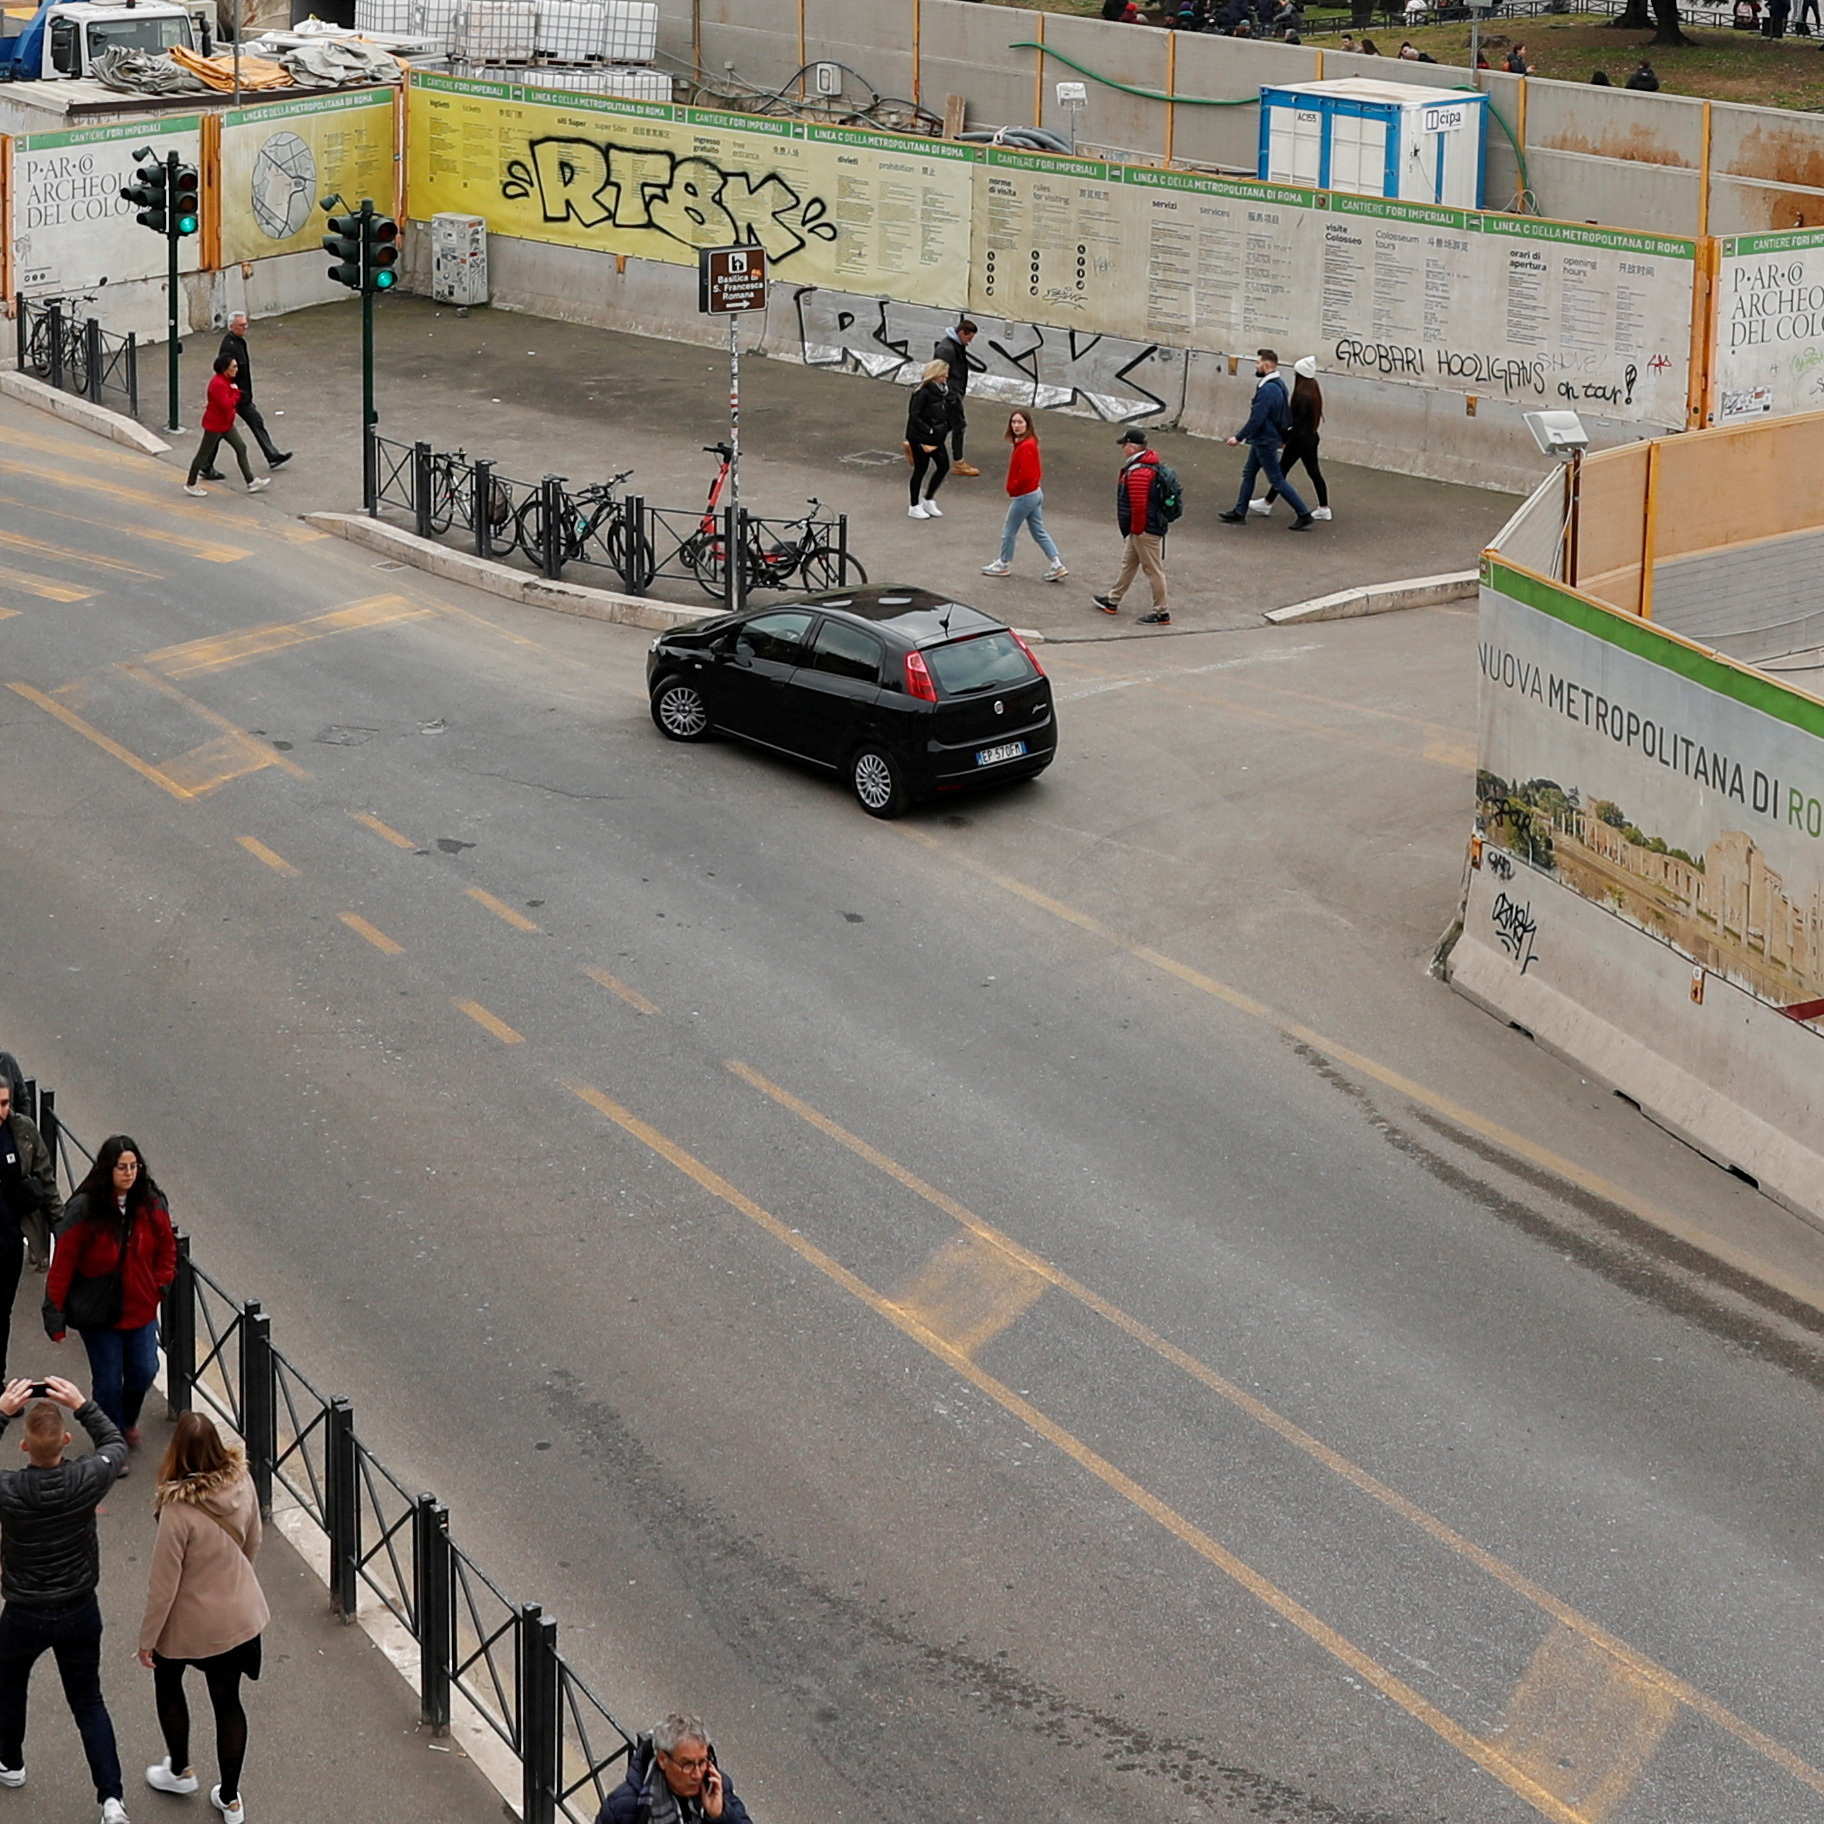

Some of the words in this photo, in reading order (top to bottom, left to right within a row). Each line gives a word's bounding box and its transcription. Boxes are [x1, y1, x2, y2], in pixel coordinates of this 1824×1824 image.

[427, 77, 453, 90] CANTIERE
[470, 82, 503, 96] IMPERIALI
[243, 108, 262, 122] LINEA
[269, 103, 289, 117] DELLA
[290, 97, 344, 115] METROPOLITANA
[579, 96, 635, 113] METROPOLITANA
[695, 113, 728, 125] CANTIERE
[747, 120, 783, 133] IMPERIALI
[1440, 110, 1461, 126] cipa
[70, 129, 105, 143] CANTIERE
[125, 124, 161, 137] IMPERIALI
[844, 133, 867, 144] DELLA
[868, 136, 930, 153] METROPOLITANA
[941, 146, 964, 157] ROMA
[879, 162, 914, 173] prohibition
[997, 154, 1034, 167] CANTIERE
[1056, 161, 1097, 176] IMPERIALI
[1133, 172, 1158, 184] LINEA
[1167, 176, 1193, 189] DELLA
[1195, 176, 1264, 199] METROPOLITANA
[1278, 191, 1303, 204] ROMA
[1043, 193, 1069, 206] visiting
[1152, 200, 1177, 210] servizi
[27, 202, 66, 229] DEL
[1200, 207, 1230, 218] services
[1342, 200, 1384, 214] CANTIERE
[1385, 205, 1406, 217] FORI
[1408, 208, 1454, 224] IMPERIALI
[1325, 233, 1362, 246] Colosseo
[1376, 230, 1419, 244] Colosseum
[1493, 221, 1521, 233] LINEA
[1532, 225, 1562, 238] DELLA
[1562, 227, 1642, 249] METROPOLITANA
[1658, 241, 1685, 255] ROMA
[1753, 236, 1790, 251] CANTIERE
[1509, 260, 1547, 272] apertura
[1563, 266, 1587, 277] hours
[1564, 257, 1597, 270] opening
[718, 275, 749, 284] Basilica
[724, 282, 764, 292] Francesca
[722, 292, 754, 300] Romana
[1730, 319, 1771, 347] DEL
[1336, 339, 1424, 375] GROBARI
[1437, 349, 1545, 394] HOOLIGANS
[1558, 381, 1580, 401] on
[1582, 364, 1637, 405] tour!
[1549, 673, 1745, 804] METROPOLITANA
[1753, 770, 1778, 819] DI
